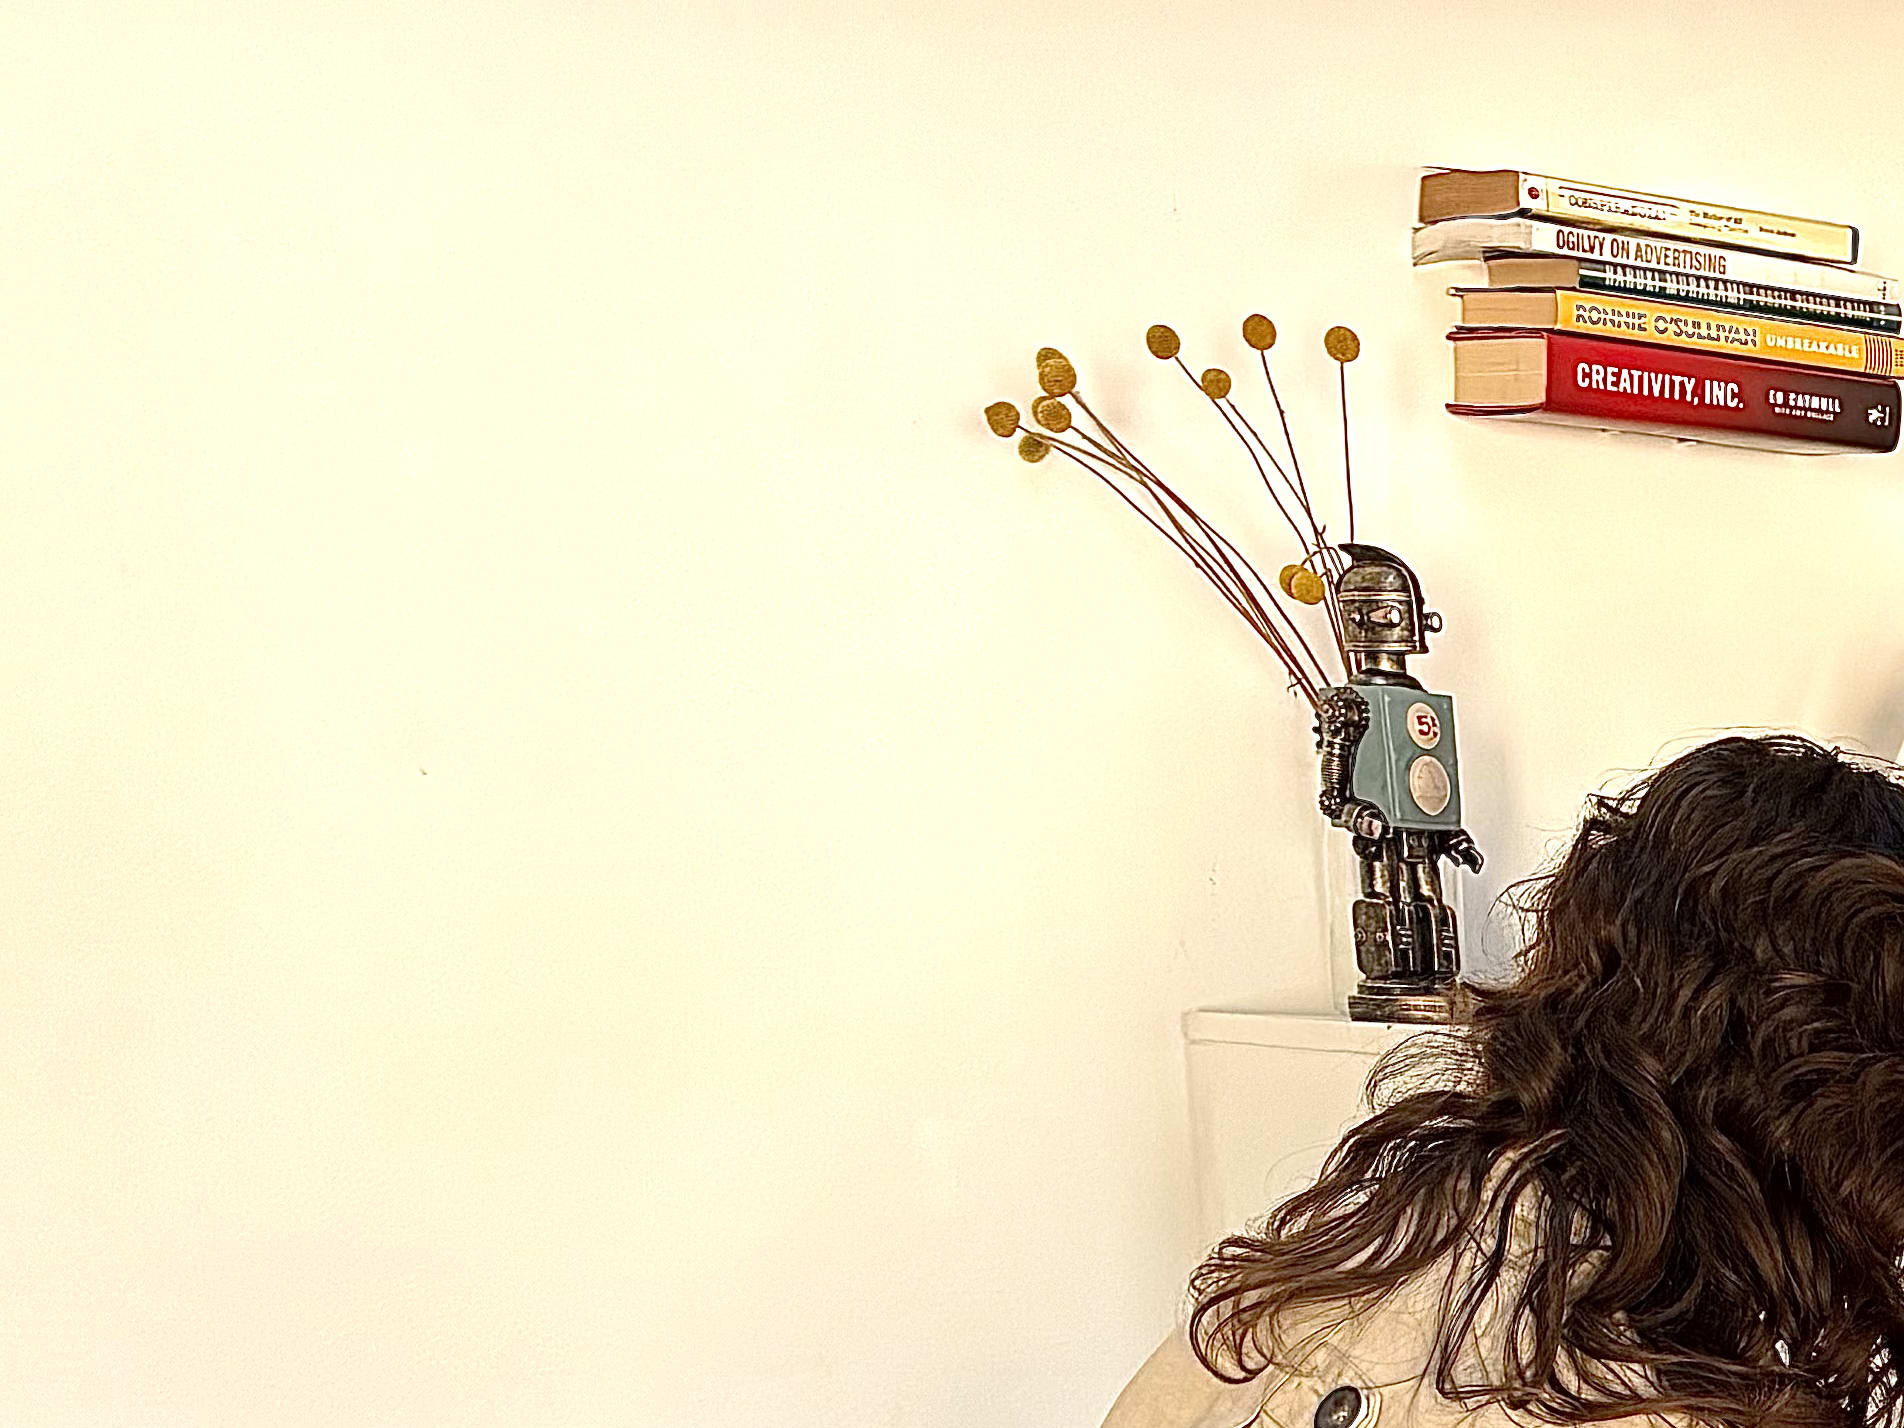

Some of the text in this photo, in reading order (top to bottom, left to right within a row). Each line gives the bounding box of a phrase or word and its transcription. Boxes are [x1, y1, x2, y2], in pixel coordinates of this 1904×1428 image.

[1556, 229, 1727, 275] OGILVY ON ADVERTISING
[1605, 264, 1660, 292] HARUKI
[1665, 272, 1744, 305] MURAKAMI
[1575, 304, 1647, 332] RONNIE
[1765, 334, 1860, 359] UNBREAKABLE
[1576, 362, 1744, 409] CREATIVITY, INC.
